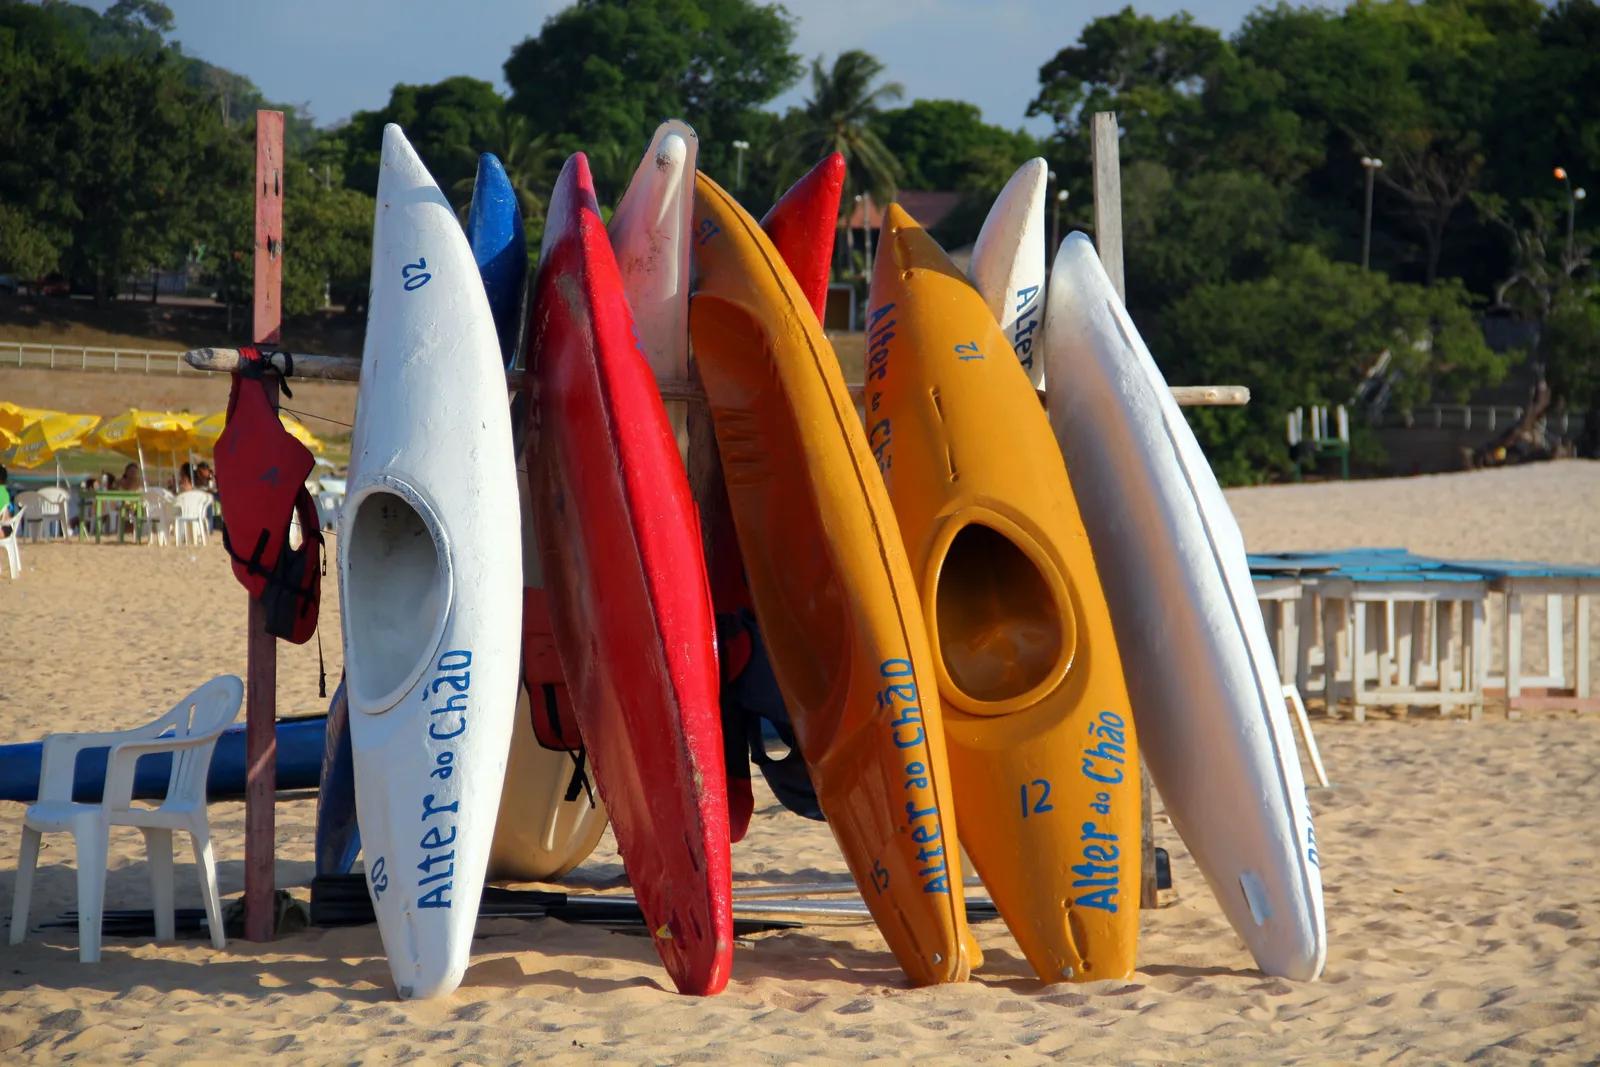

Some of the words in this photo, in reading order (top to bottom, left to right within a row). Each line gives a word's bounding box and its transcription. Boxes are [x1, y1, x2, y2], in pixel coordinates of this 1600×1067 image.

[422, 649, 473, 740] Chão
[877, 658, 926, 750] Chão
[430, 751, 454, 780] do
[904, 761, 928, 790] do
[1081, 711, 1126, 784] Chão
[1020, 779, 1054, 819] 12
[1089, 791, 1111, 815] do
[1071, 821, 1120, 914] Alter
